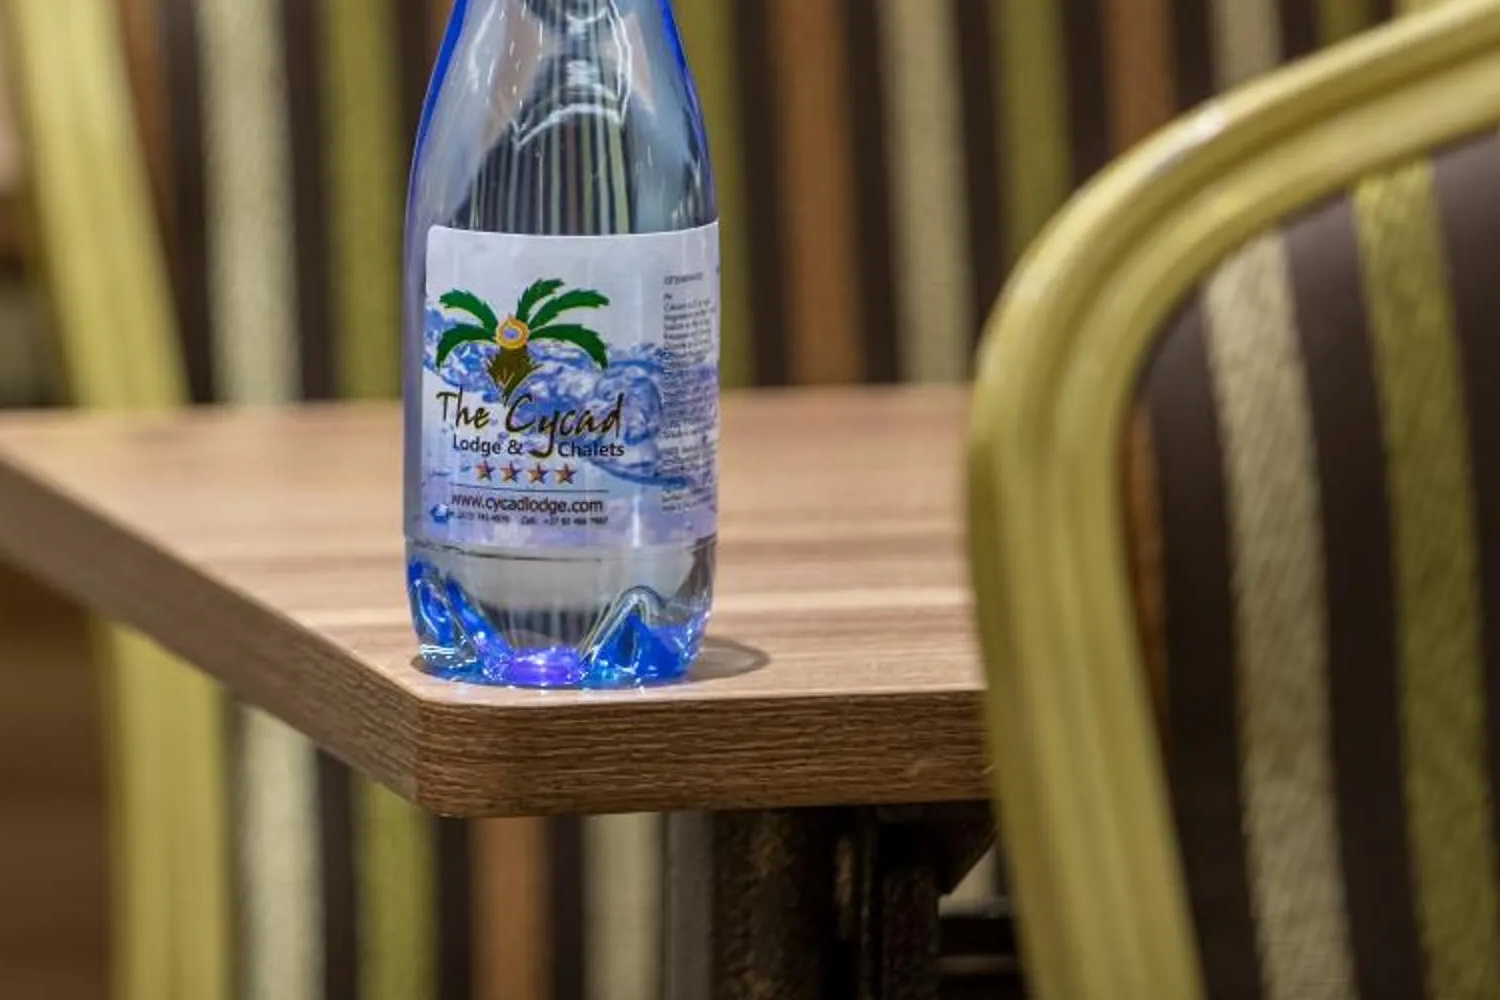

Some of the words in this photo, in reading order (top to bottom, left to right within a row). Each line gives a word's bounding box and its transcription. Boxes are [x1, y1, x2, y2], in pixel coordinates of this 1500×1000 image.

[436, 386, 490, 429] The
[505, 392, 625, 458] Cycad
[453, 434, 500, 457] Lodge
[507, 439, 523, 455] &
[557, 440, 625, 458] Chalets
[451, 494, 603, 516] www.cycadlodge.com
